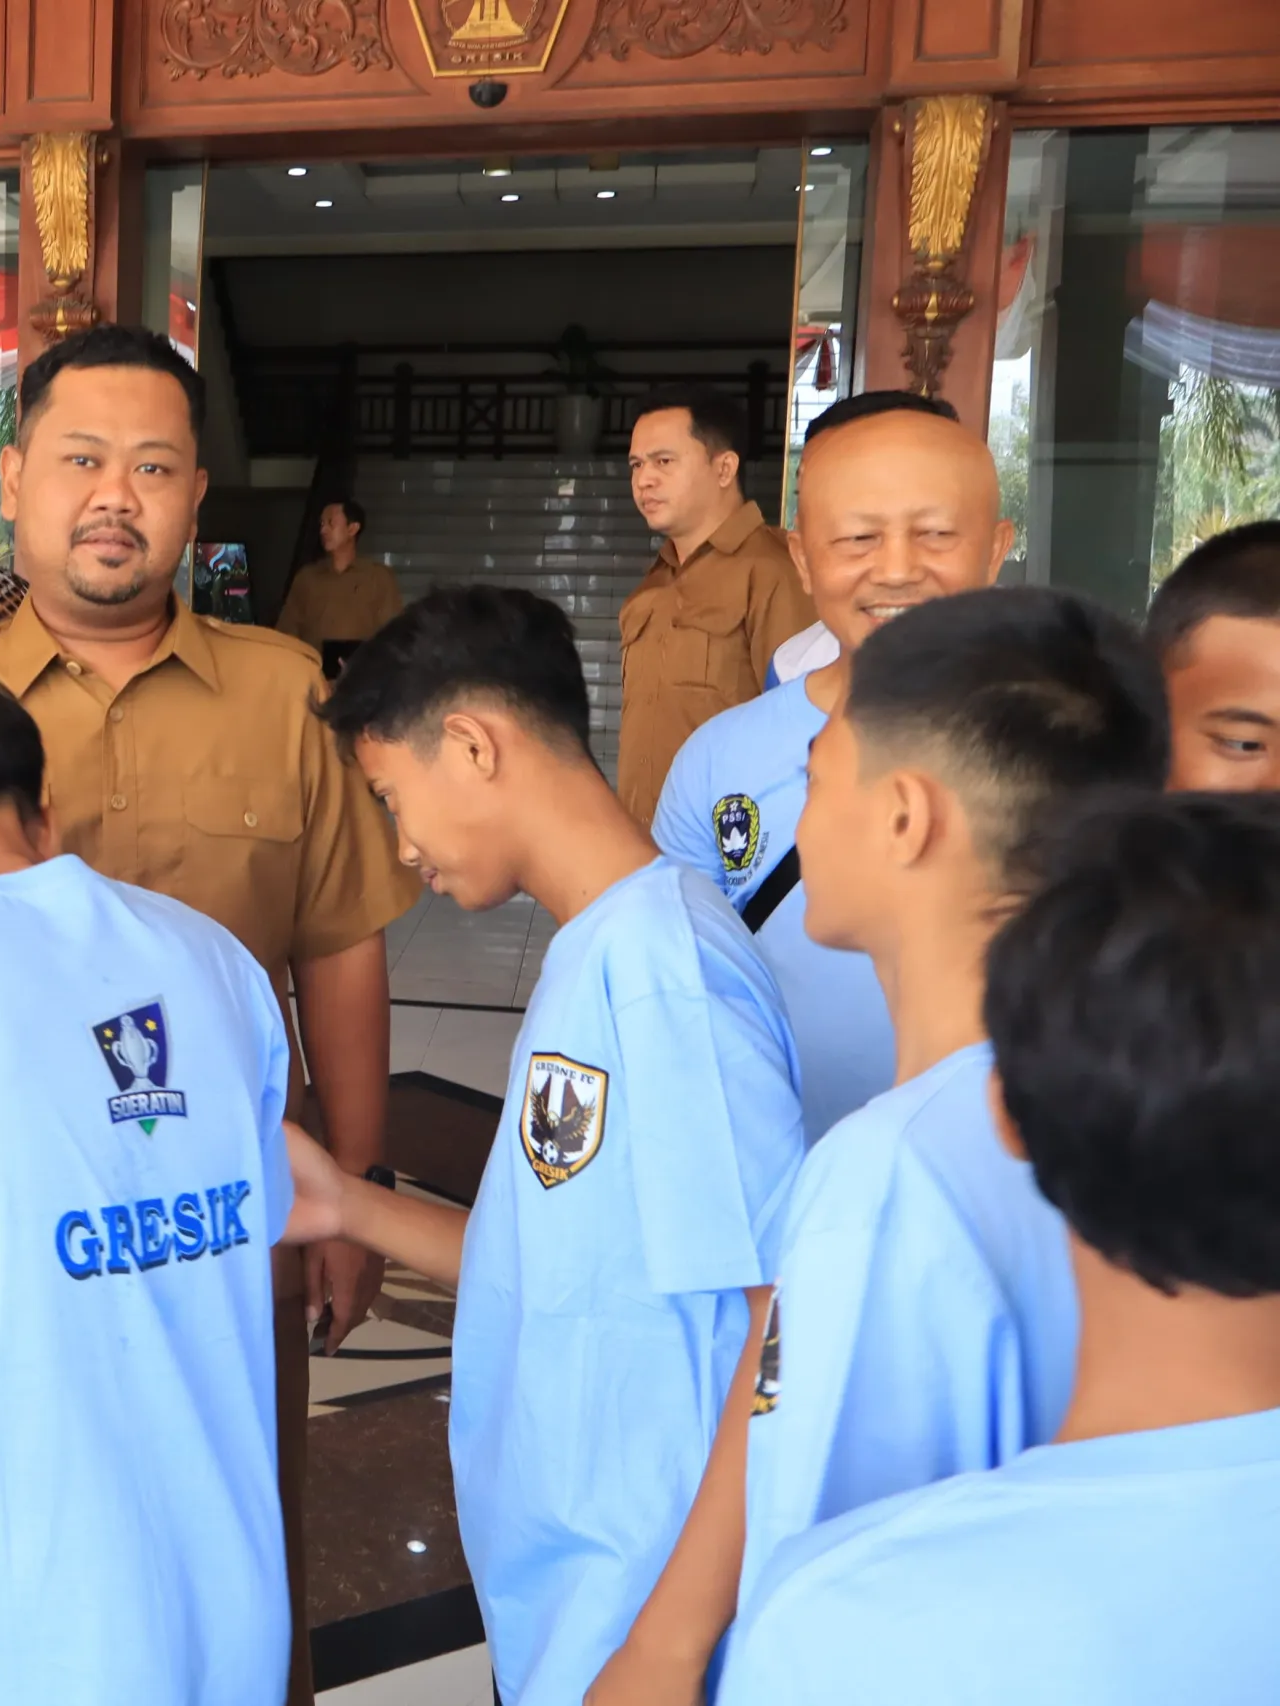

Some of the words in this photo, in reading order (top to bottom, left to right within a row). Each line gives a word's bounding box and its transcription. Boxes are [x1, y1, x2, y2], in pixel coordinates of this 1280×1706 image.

[722, 812, 746, 825] PSSI
[580, 1072, 596, 1085] FC
[110, 1091, 184, 1121] SOERATIN
[55, 1179, 251, 1281] GRESIK
